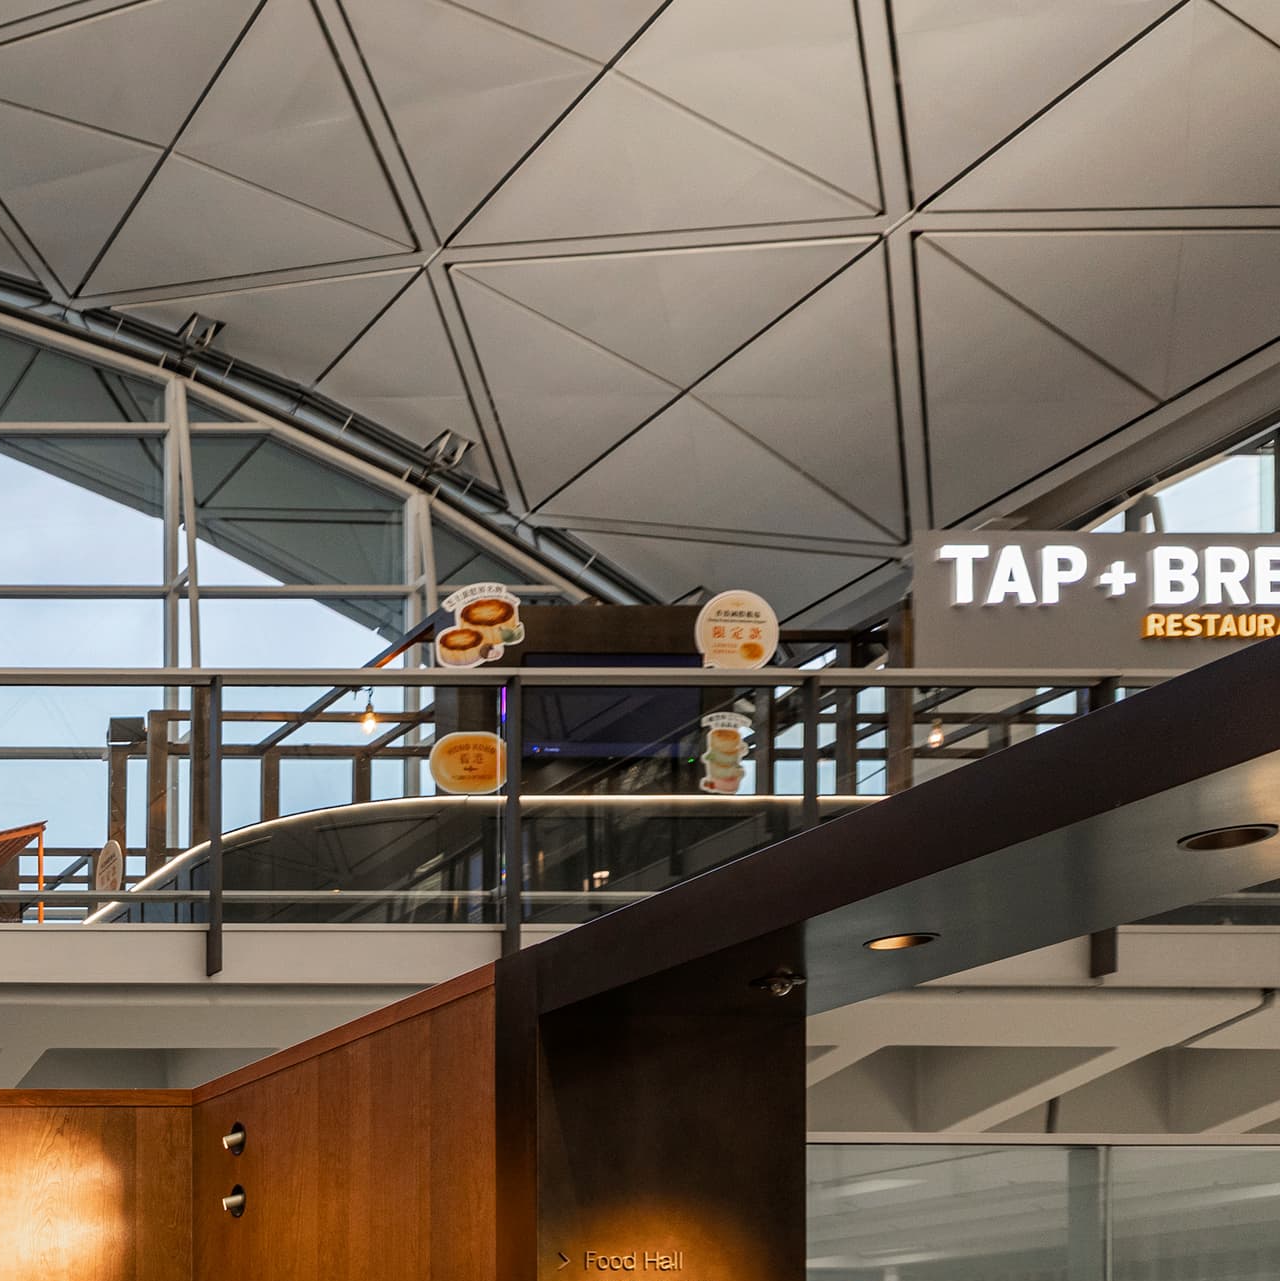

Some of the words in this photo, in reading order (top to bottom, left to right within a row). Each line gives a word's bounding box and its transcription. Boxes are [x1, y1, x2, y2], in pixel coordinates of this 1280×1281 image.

[937, 544, 1089, 605] TAP
[1144, 612, 1280, 638] RESTAUR
[584, 1250, 637, 1271] Food
[643, 1250, 683, 1271] Hall
